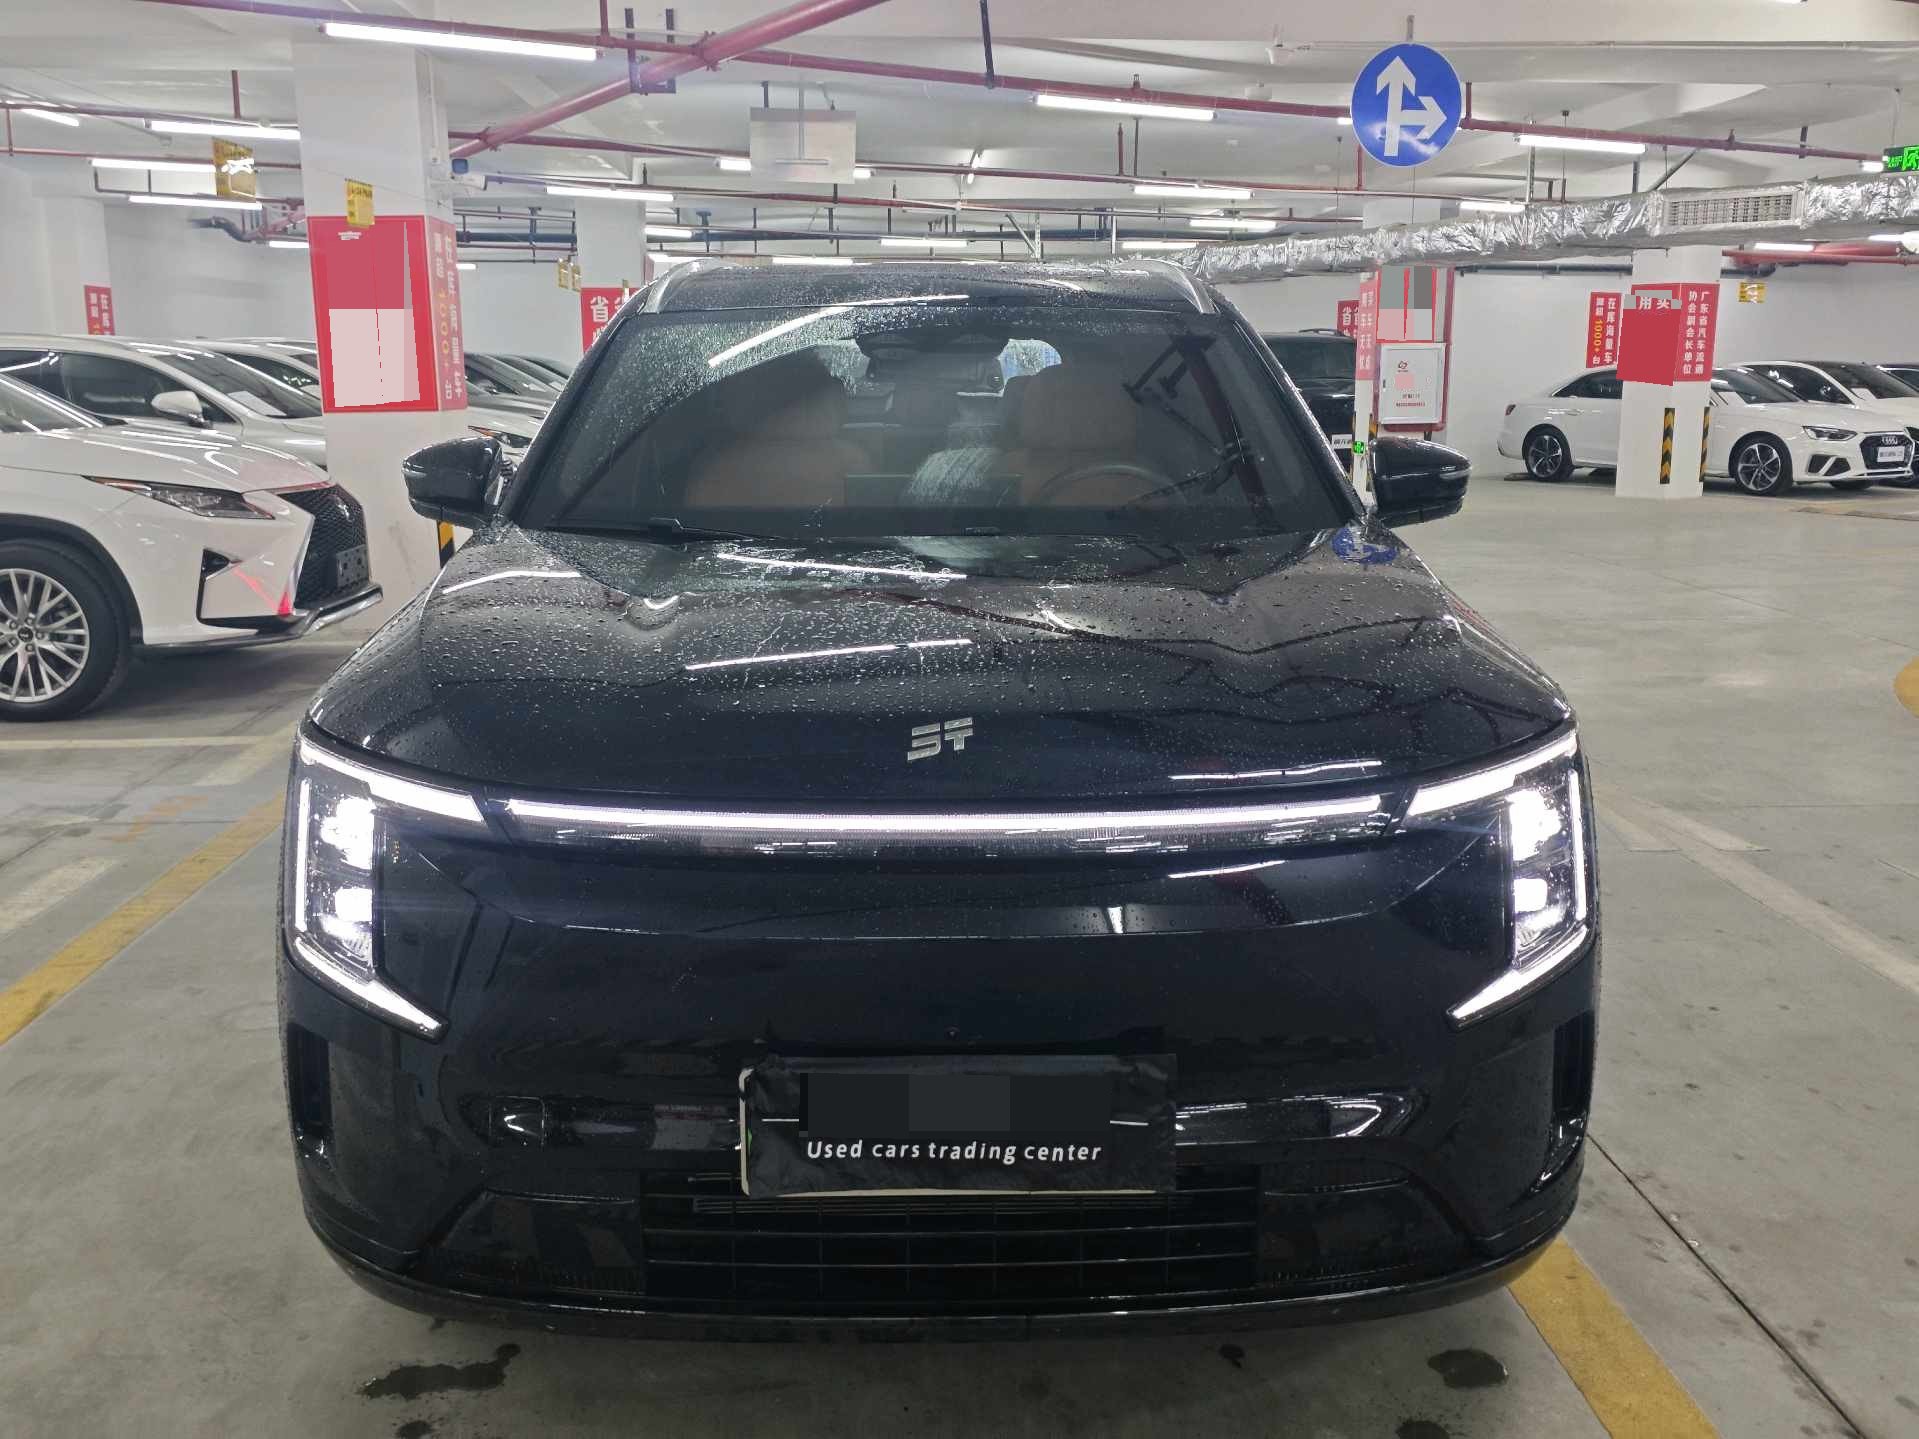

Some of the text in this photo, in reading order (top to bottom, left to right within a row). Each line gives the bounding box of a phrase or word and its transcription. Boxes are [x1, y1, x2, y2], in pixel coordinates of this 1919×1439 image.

[807, 1139, 1102, 1166] Used cars trading center
